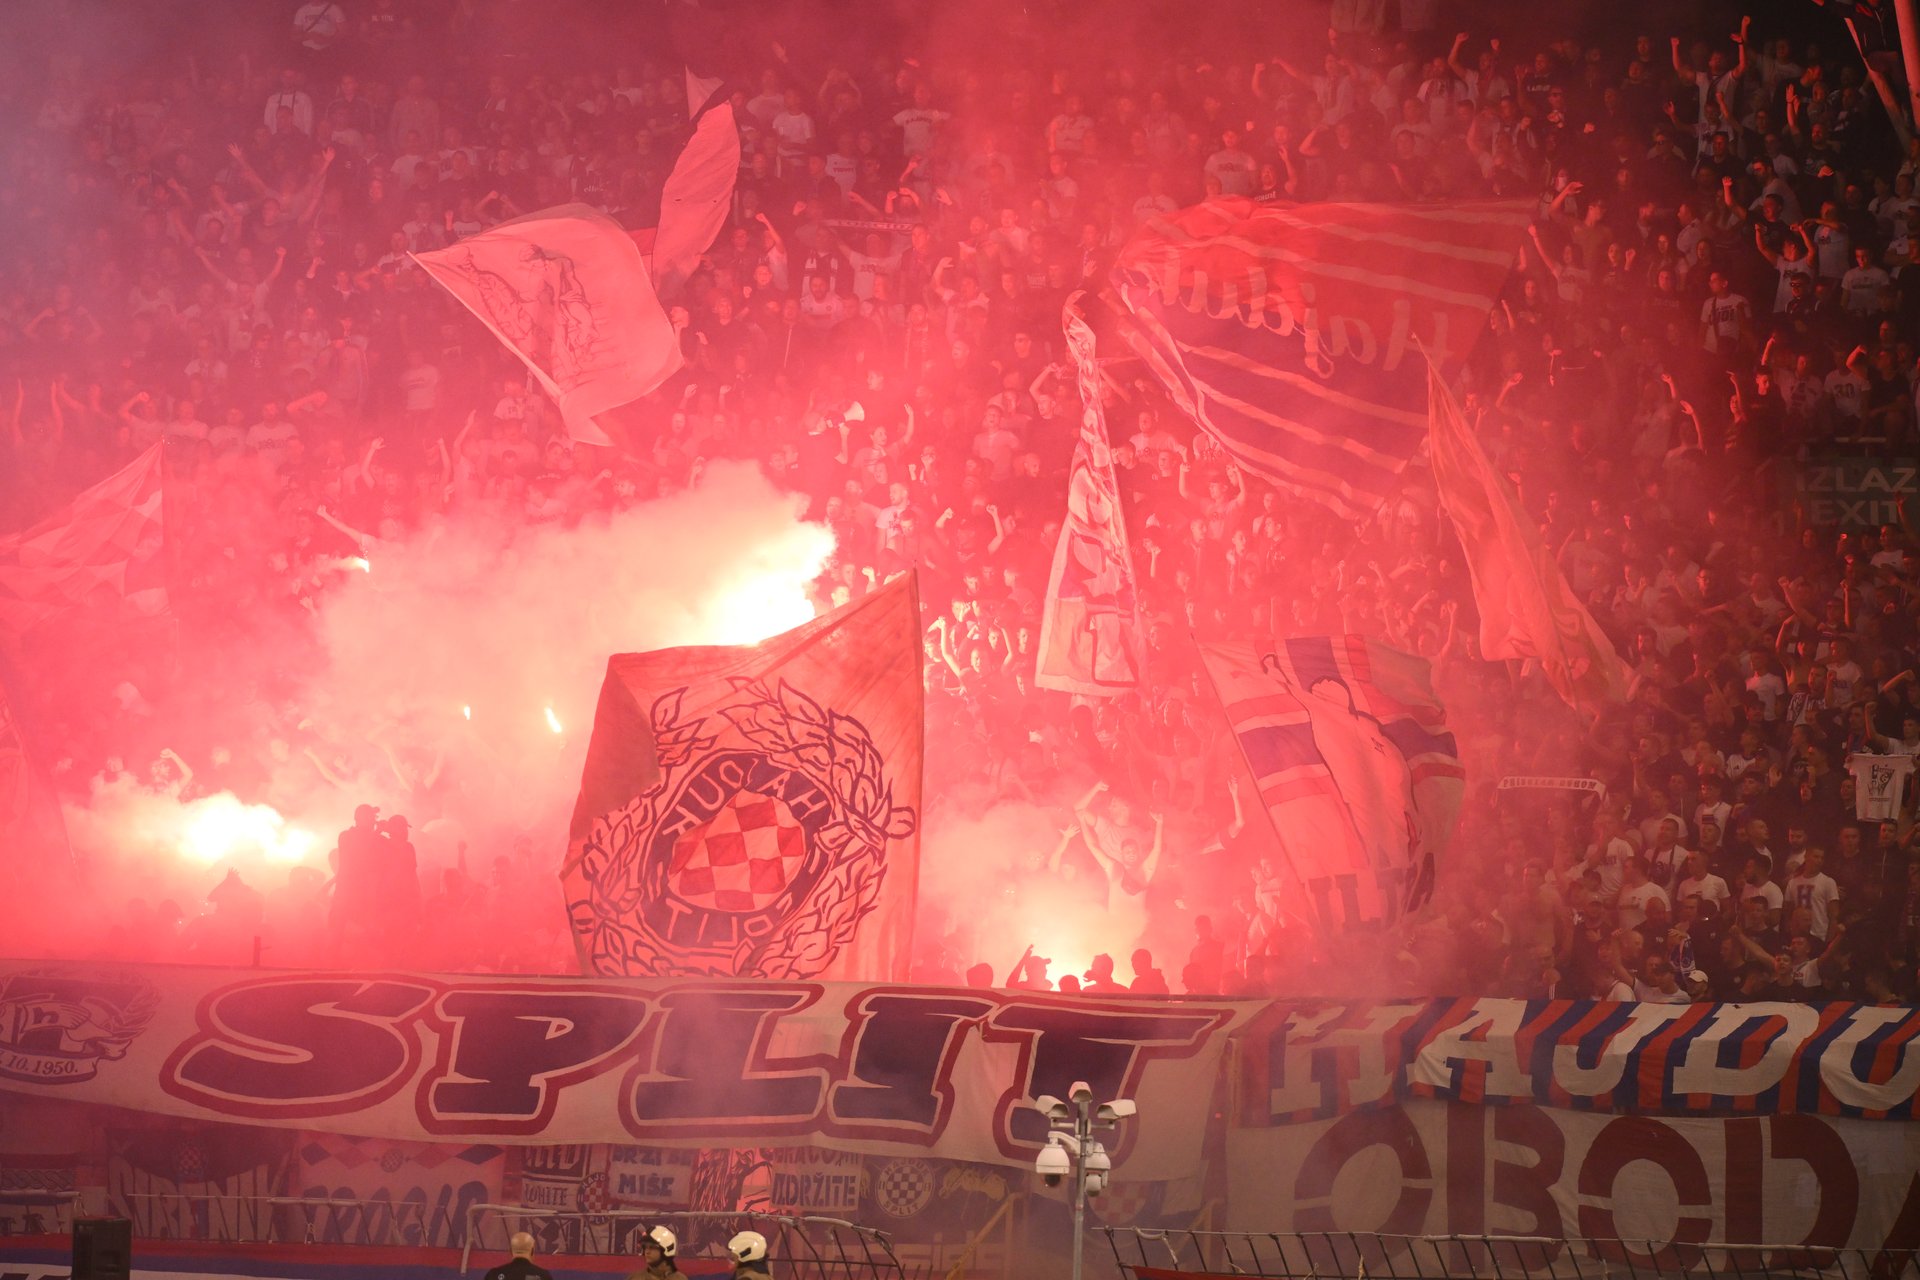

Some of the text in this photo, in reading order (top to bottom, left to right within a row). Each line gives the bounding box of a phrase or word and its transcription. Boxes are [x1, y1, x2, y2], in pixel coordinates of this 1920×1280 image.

[1796, 466, 1918, 492] IZLAZ
[1811, 499, 1897, 526] EXIT
[160, 972, 1236, 1170] SPLIT
[618, 1171, 675, 1197] MIŠE
[884, 1200, 920, 1215] SPLIT
